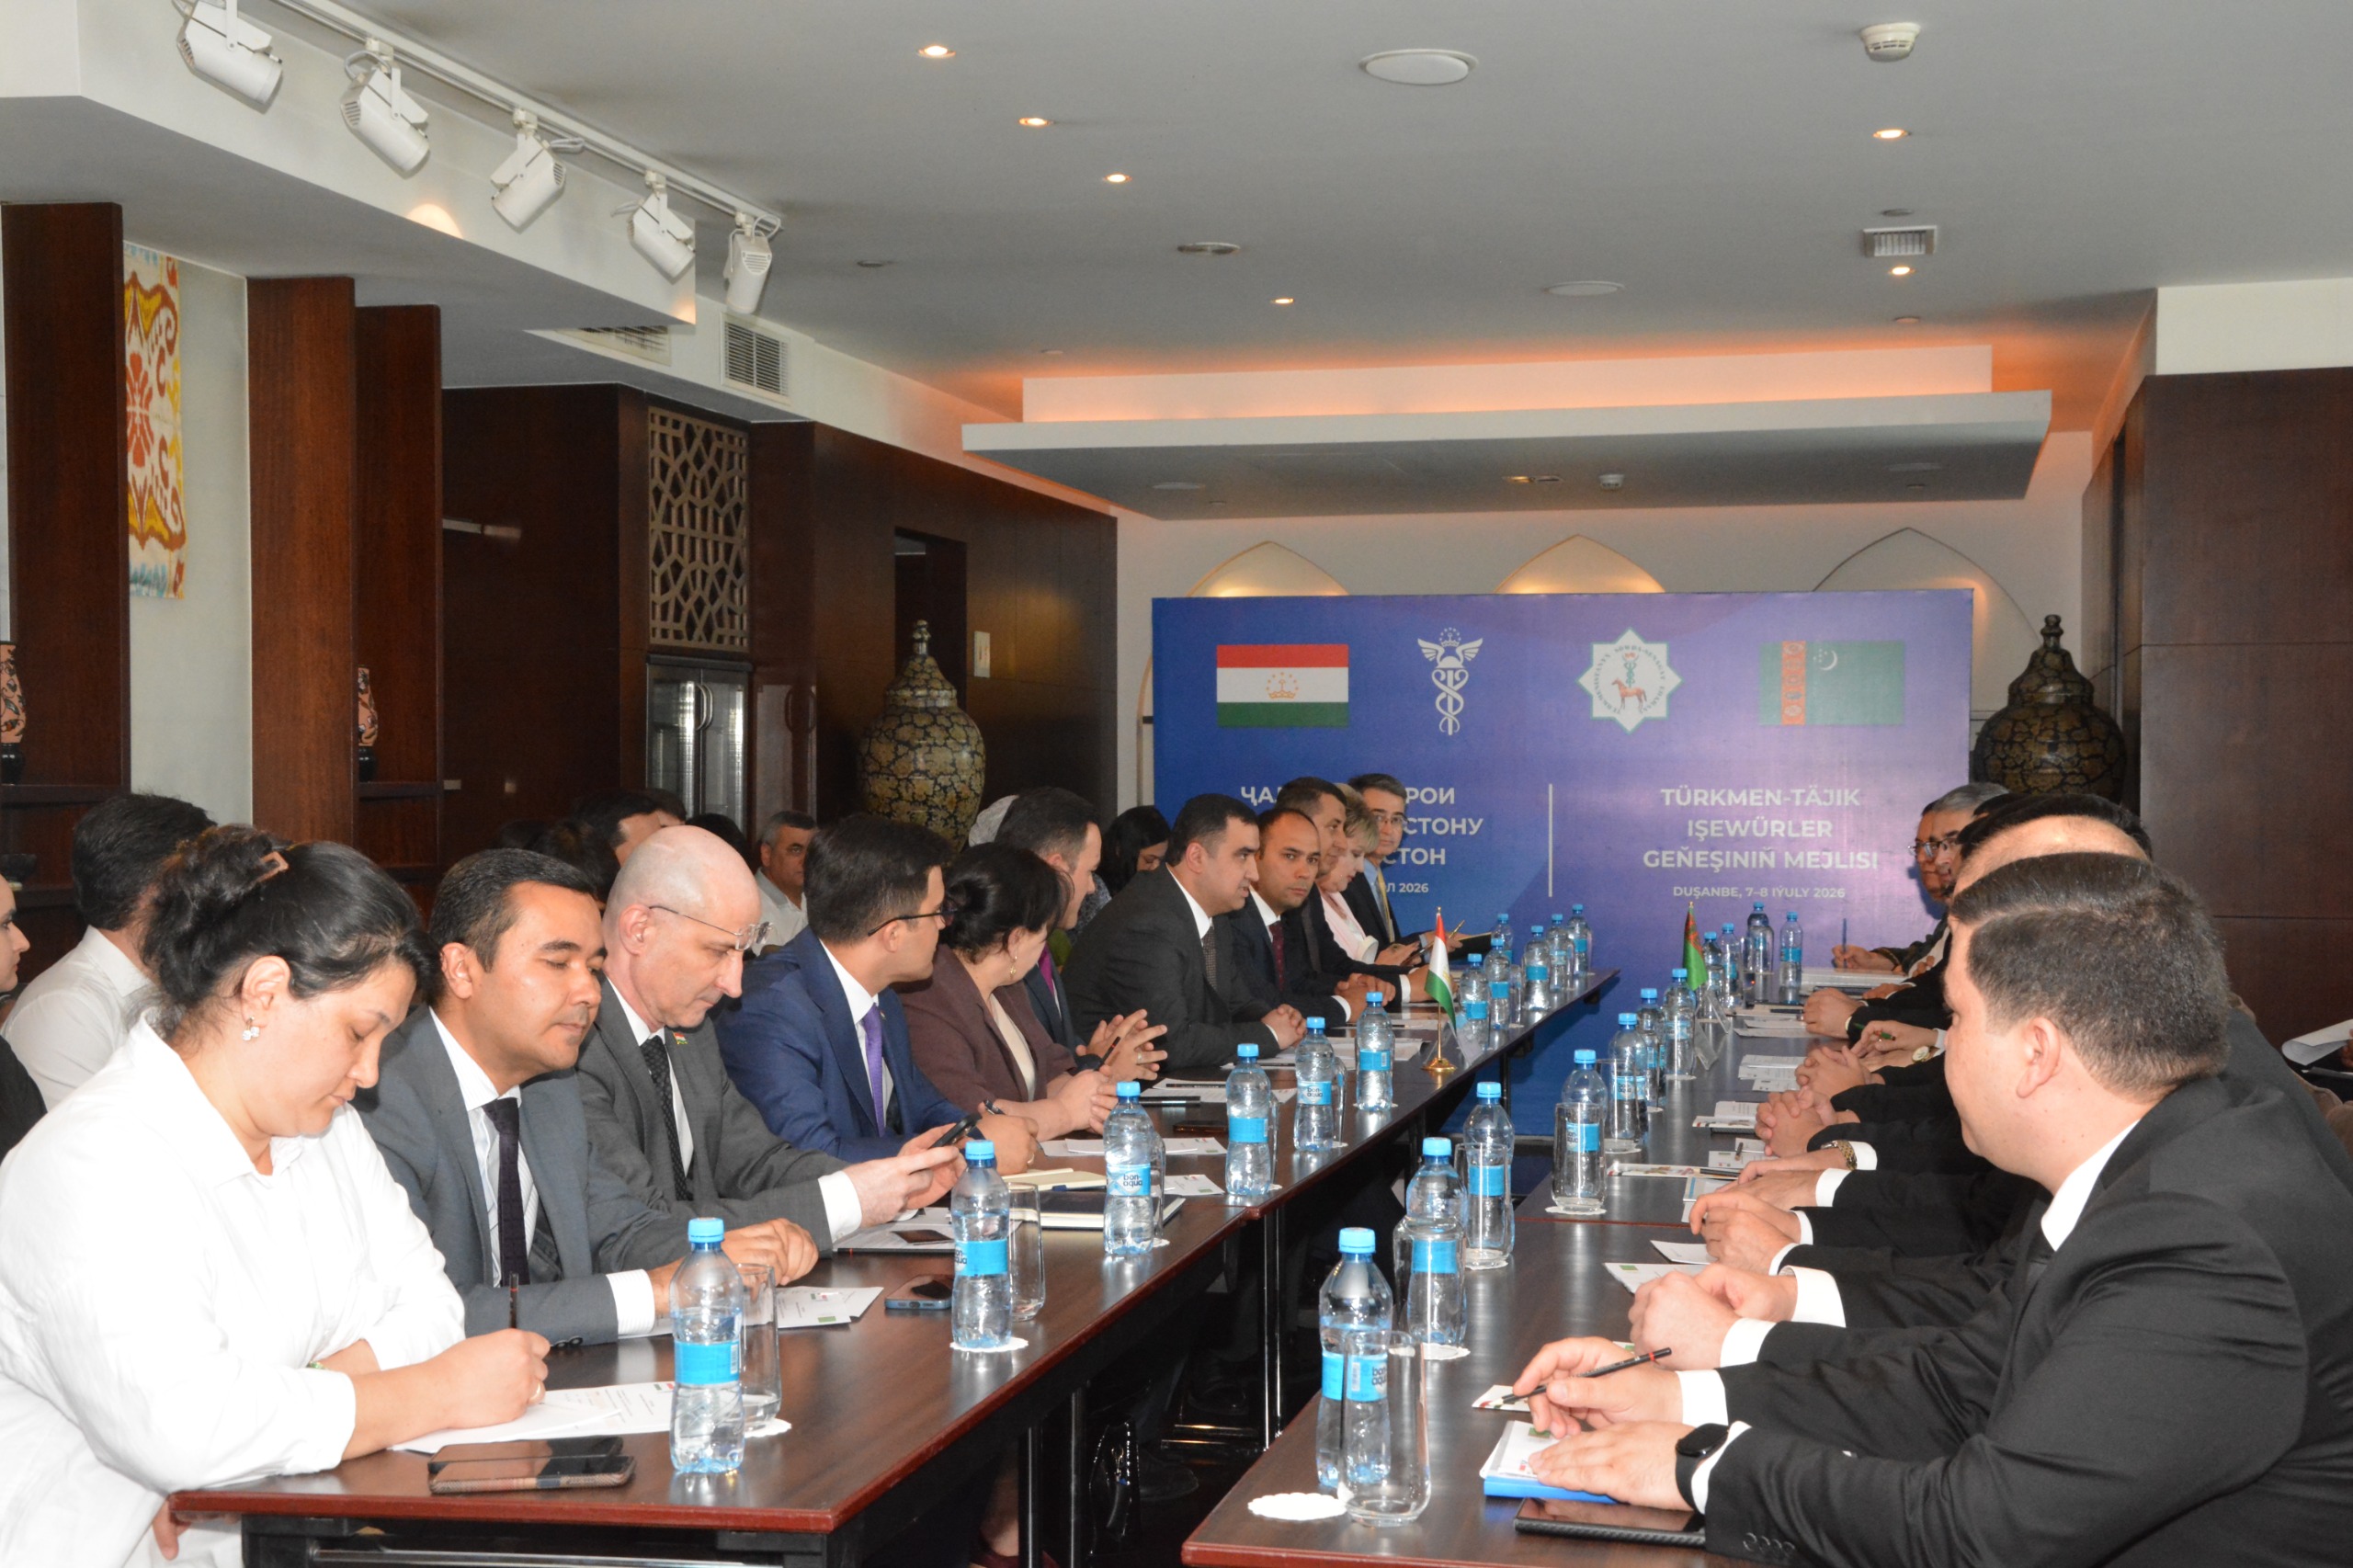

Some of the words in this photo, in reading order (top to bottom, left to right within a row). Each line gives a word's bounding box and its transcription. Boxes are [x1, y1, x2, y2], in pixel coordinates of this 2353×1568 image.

[1404, 787, 1455, 804] РОИ
[1661, 785, 1860, 806] TÜRKMEN-TÄJIK
[1403, 817, 1483, 835] СТОНУ
[1688, 815, 1833, 842] IŞEWÜRLER
[1643, 846, 1776, 873] GEŇEŞINIŇ
[1784, 851, 1878, 869] MEJLISI
[1399, 883, 1429, 893] 2026
[1673, 886, 1742, 900] DUŞANBE,
[1772, 885, 1810, 898] IÝULY
[1813, 888, 1846, 898] 2026
